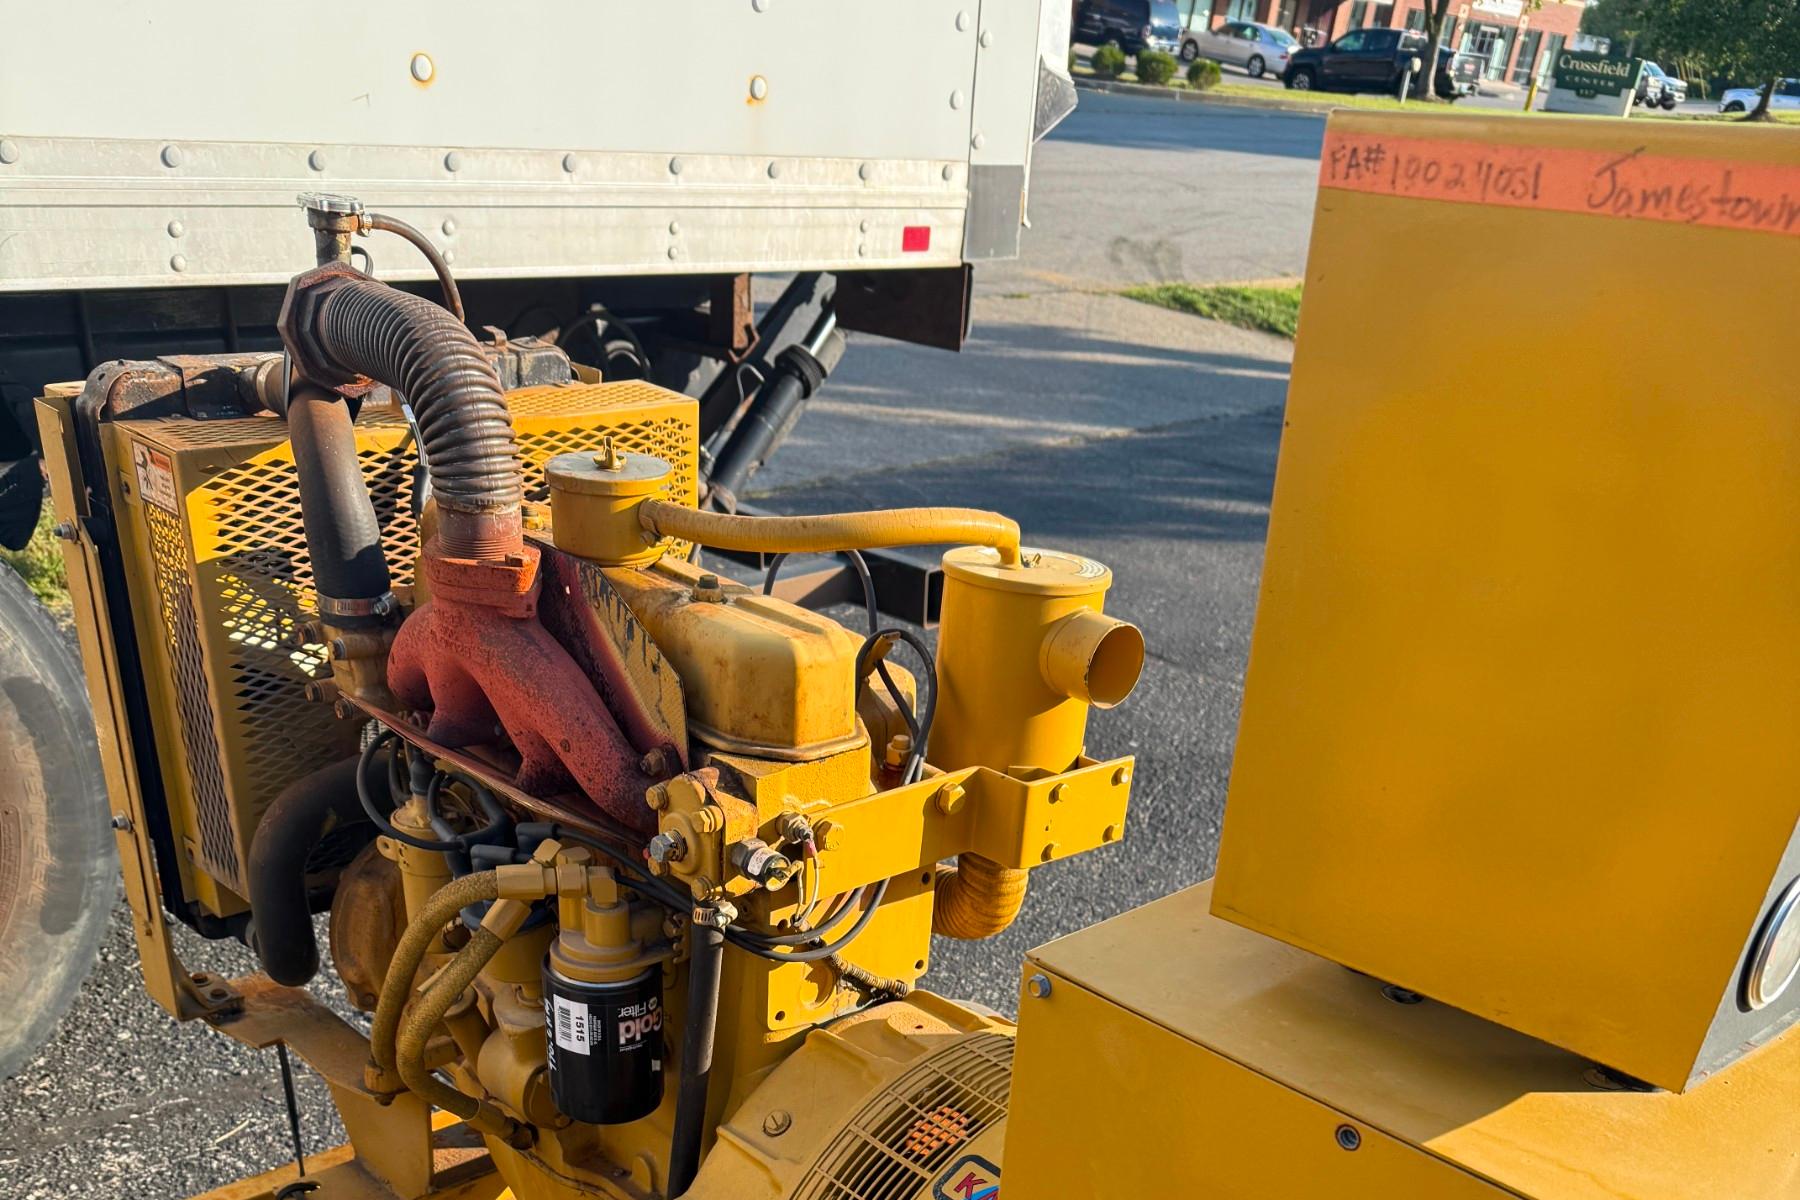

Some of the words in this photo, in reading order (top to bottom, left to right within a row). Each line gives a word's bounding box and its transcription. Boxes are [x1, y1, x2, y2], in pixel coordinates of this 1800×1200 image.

[1559, 54, 1632, 77] Crossfield
[1565, 75, 1616, 88] CENTER
[575, 1015, 585, 1043] 1515
[618, 1006, 662, 1044] Gold
